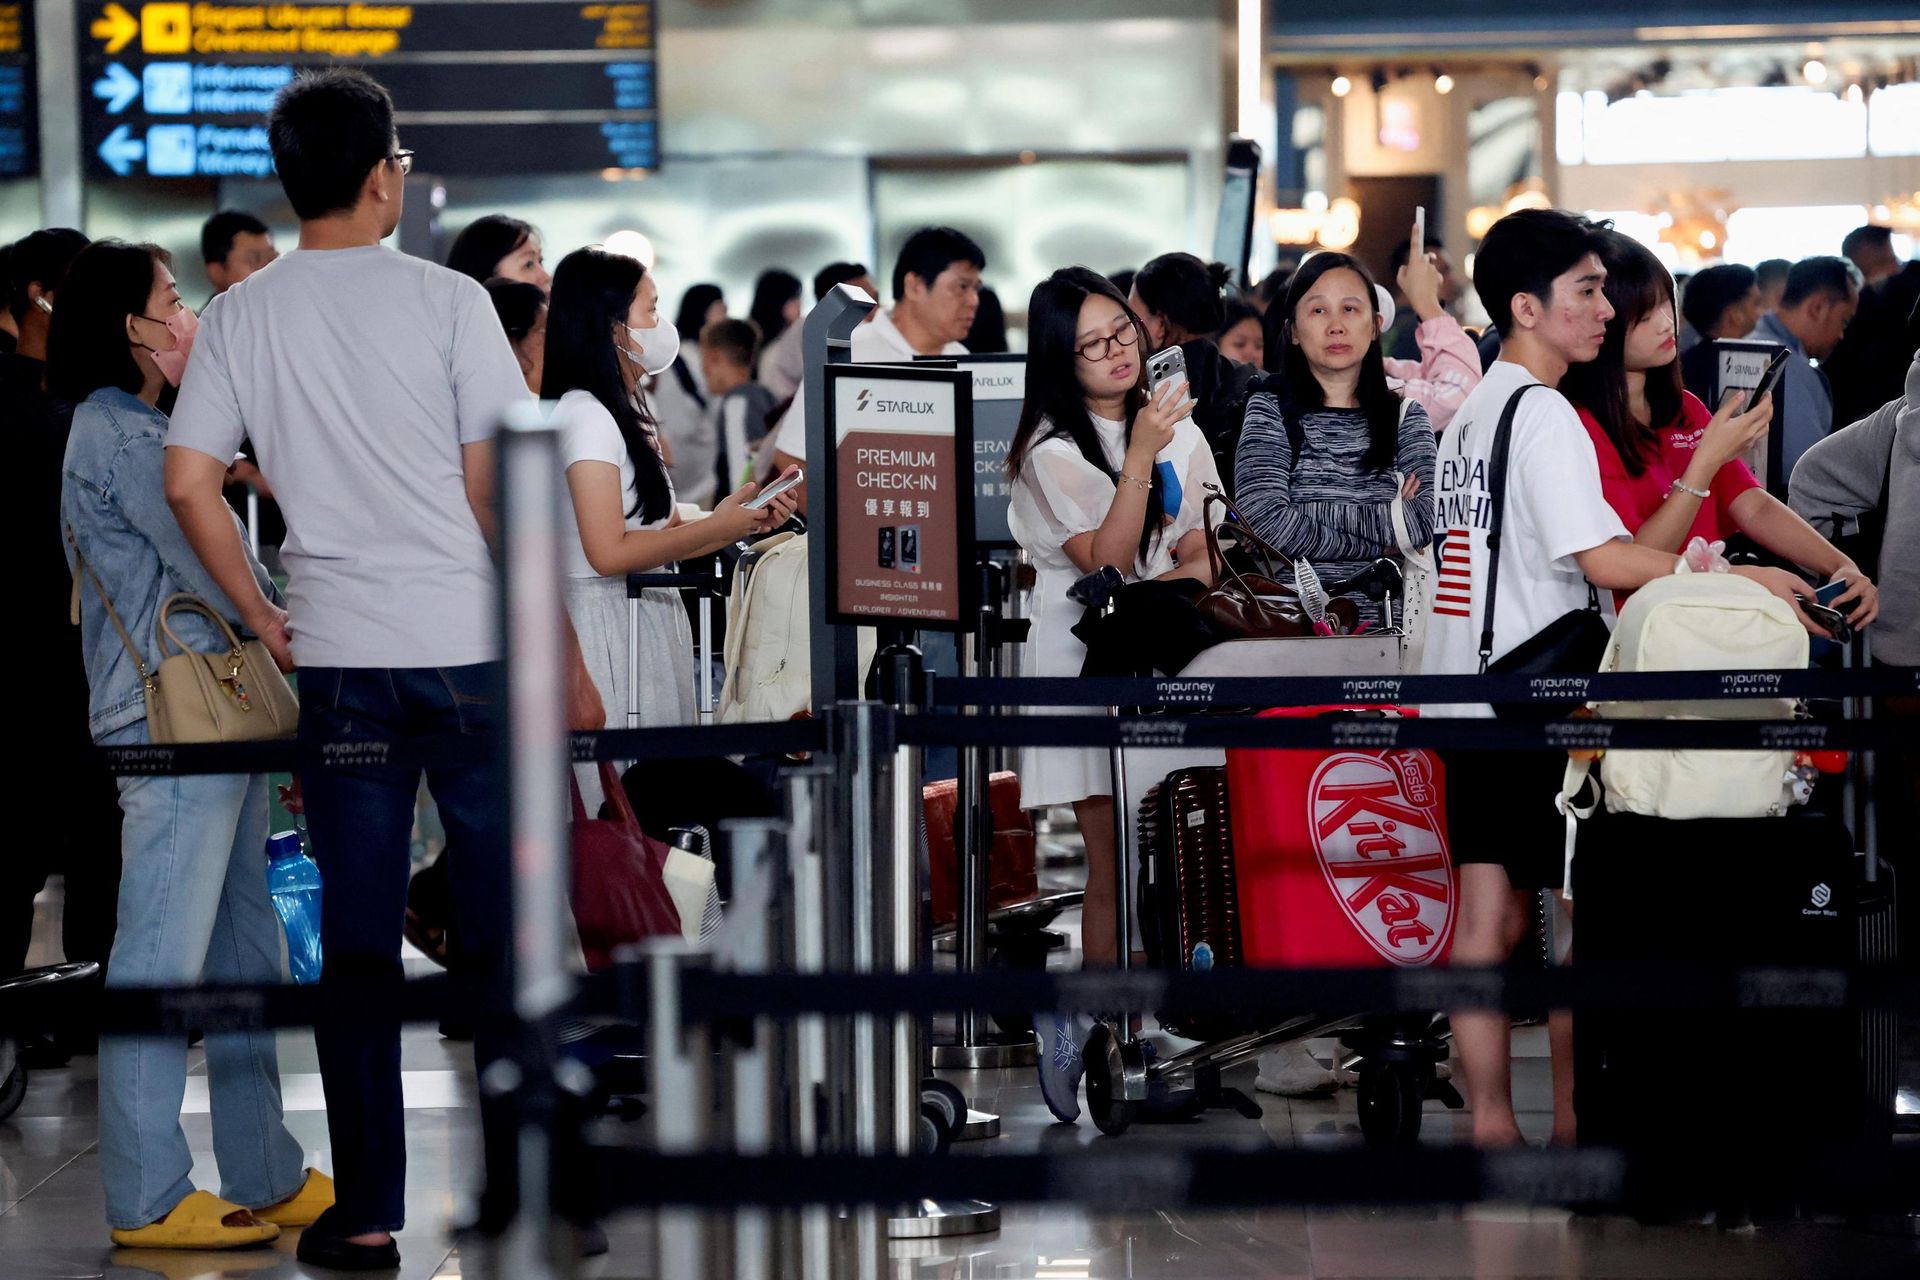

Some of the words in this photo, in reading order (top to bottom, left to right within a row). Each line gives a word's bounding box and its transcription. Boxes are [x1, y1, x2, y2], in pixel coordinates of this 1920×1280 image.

[877, 401, 934, 414] STARLUX
[857, 449, 936, 468] PREMIUM
[857, 472, 937, 491] CHECK-IN
[865, 498, 930, 518] 優享報到
[856, 579, 892, 588] BUSINESS
[894, 580, 919, 590] CLASS
[1343, 680, 1402, 692] injourney
[1530, 678, 1590, 690] injourney
[1721, 673, 1782, 686] injourney
[1156, 682, 1215, 693] injourney
[1318, 780, 1448, 948] KitKat
